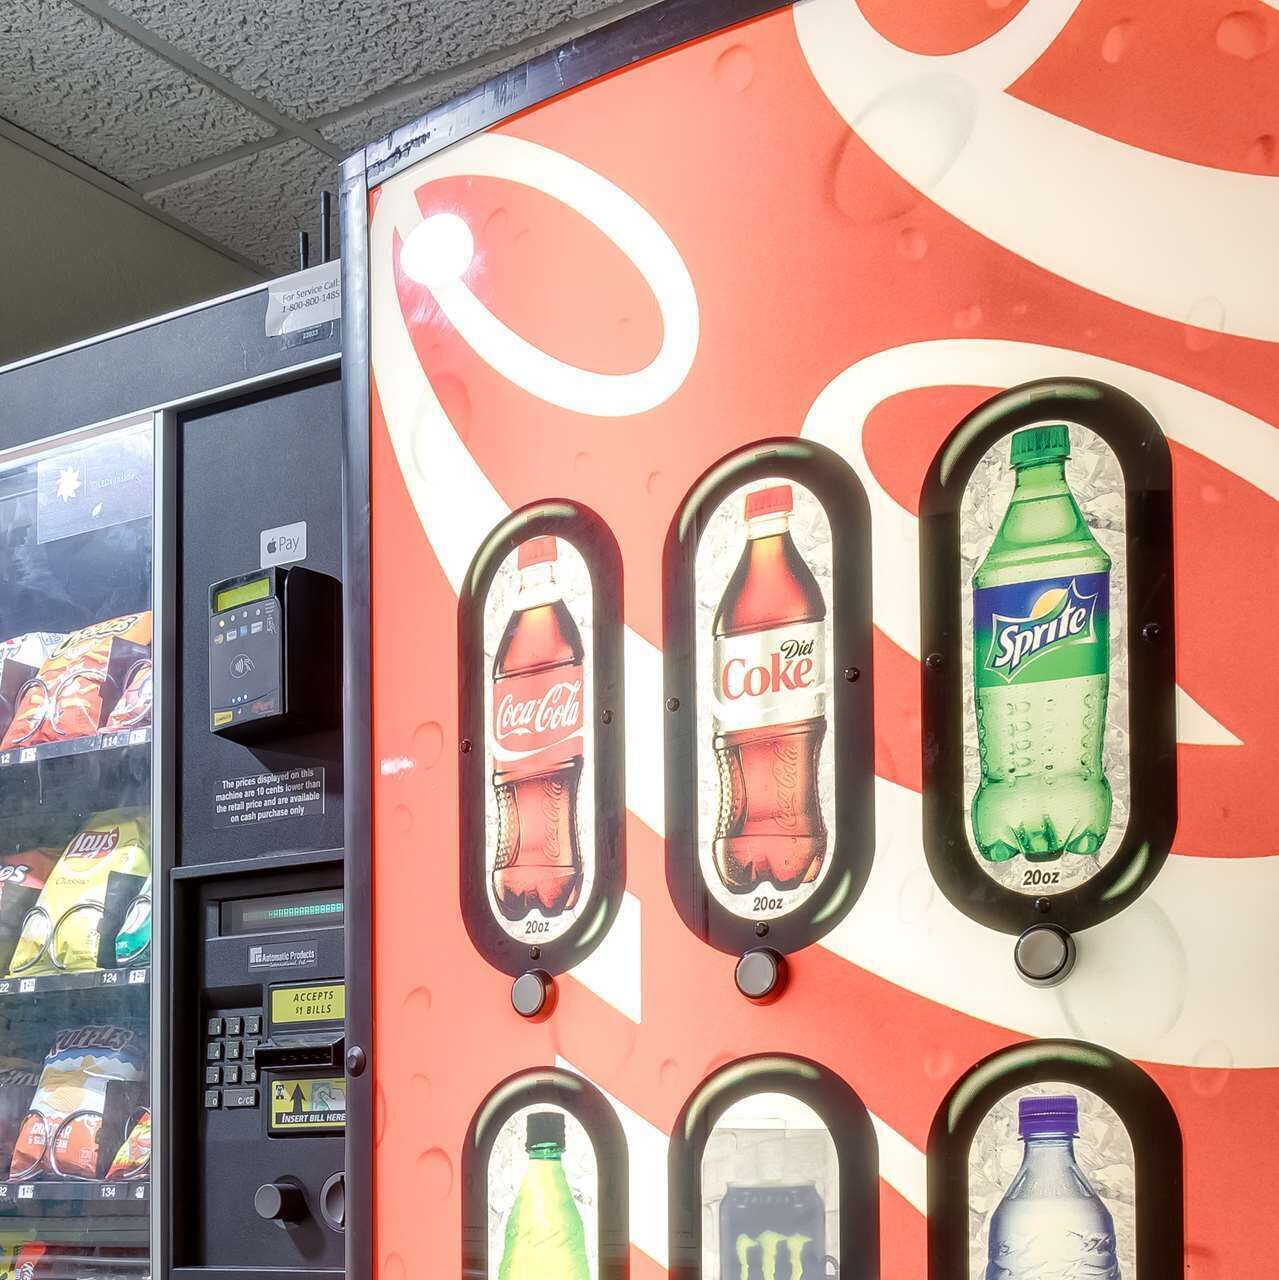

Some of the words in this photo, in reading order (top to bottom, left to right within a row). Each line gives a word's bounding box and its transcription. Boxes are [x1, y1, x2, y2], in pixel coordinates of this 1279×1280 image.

[282, 294, 294, 304] For
[296, 286, 323, 299] Service
[278, 535, 300, 552] Pay
[993, 603, 1088, 668] Sprite
[780, 638, 814, 660] Diet
[722, 654, 815, 701] Coke
[496, 679, 582, 740] Coca-Cola
[222, 780, 234, 790] The
[236, 778, 256, 789] prices
[257, 772, 289, 784] displayed
[290, 771, 300, 780] on
[301, 768, 314, 778] this
[216, 791, 243, 802] machine
[244, 790, 255, 798] are
[256, 786, 264, 796] 10
[266, 785, 284, 795] cents
[285, 782, 304, 792] lower
[306, 780, 320, 790] than
[216, 804, 227, 814] the
[228, 801, 244, 812] retail
[246, 800, 262, 811] price
[264, 796, 276, 806] and
[278, 796, 289, 804] are
[290, 791, 320, 802] available
[230, 815, 239, 823] on
[240, 812, 256, 822] cash
[258, 808, 288, 820] purchase
[290, 804, 304, 816] only
[1022, 869, 1060, 886] 20oz
[752, 896, 784, 912] 20oz
[525, 920, 550, 935] 20oz
[290, 949, 316, 960] Products
[102, 972, 118, 983] 124
[293, 990, 334, 1002] ACCEPTS
[296, 1006, 303, 1016] $1
[306, 1004, 332, 1014] BILLS
[238, 1096, 254, 1105] C/CE
[282, 1113, 310, 1123] INSERT
[310, 1113, 325, 1122] BILL
[326, 1112, 346, 1122] HERE
[101, 1186, 116, 1198] 134
